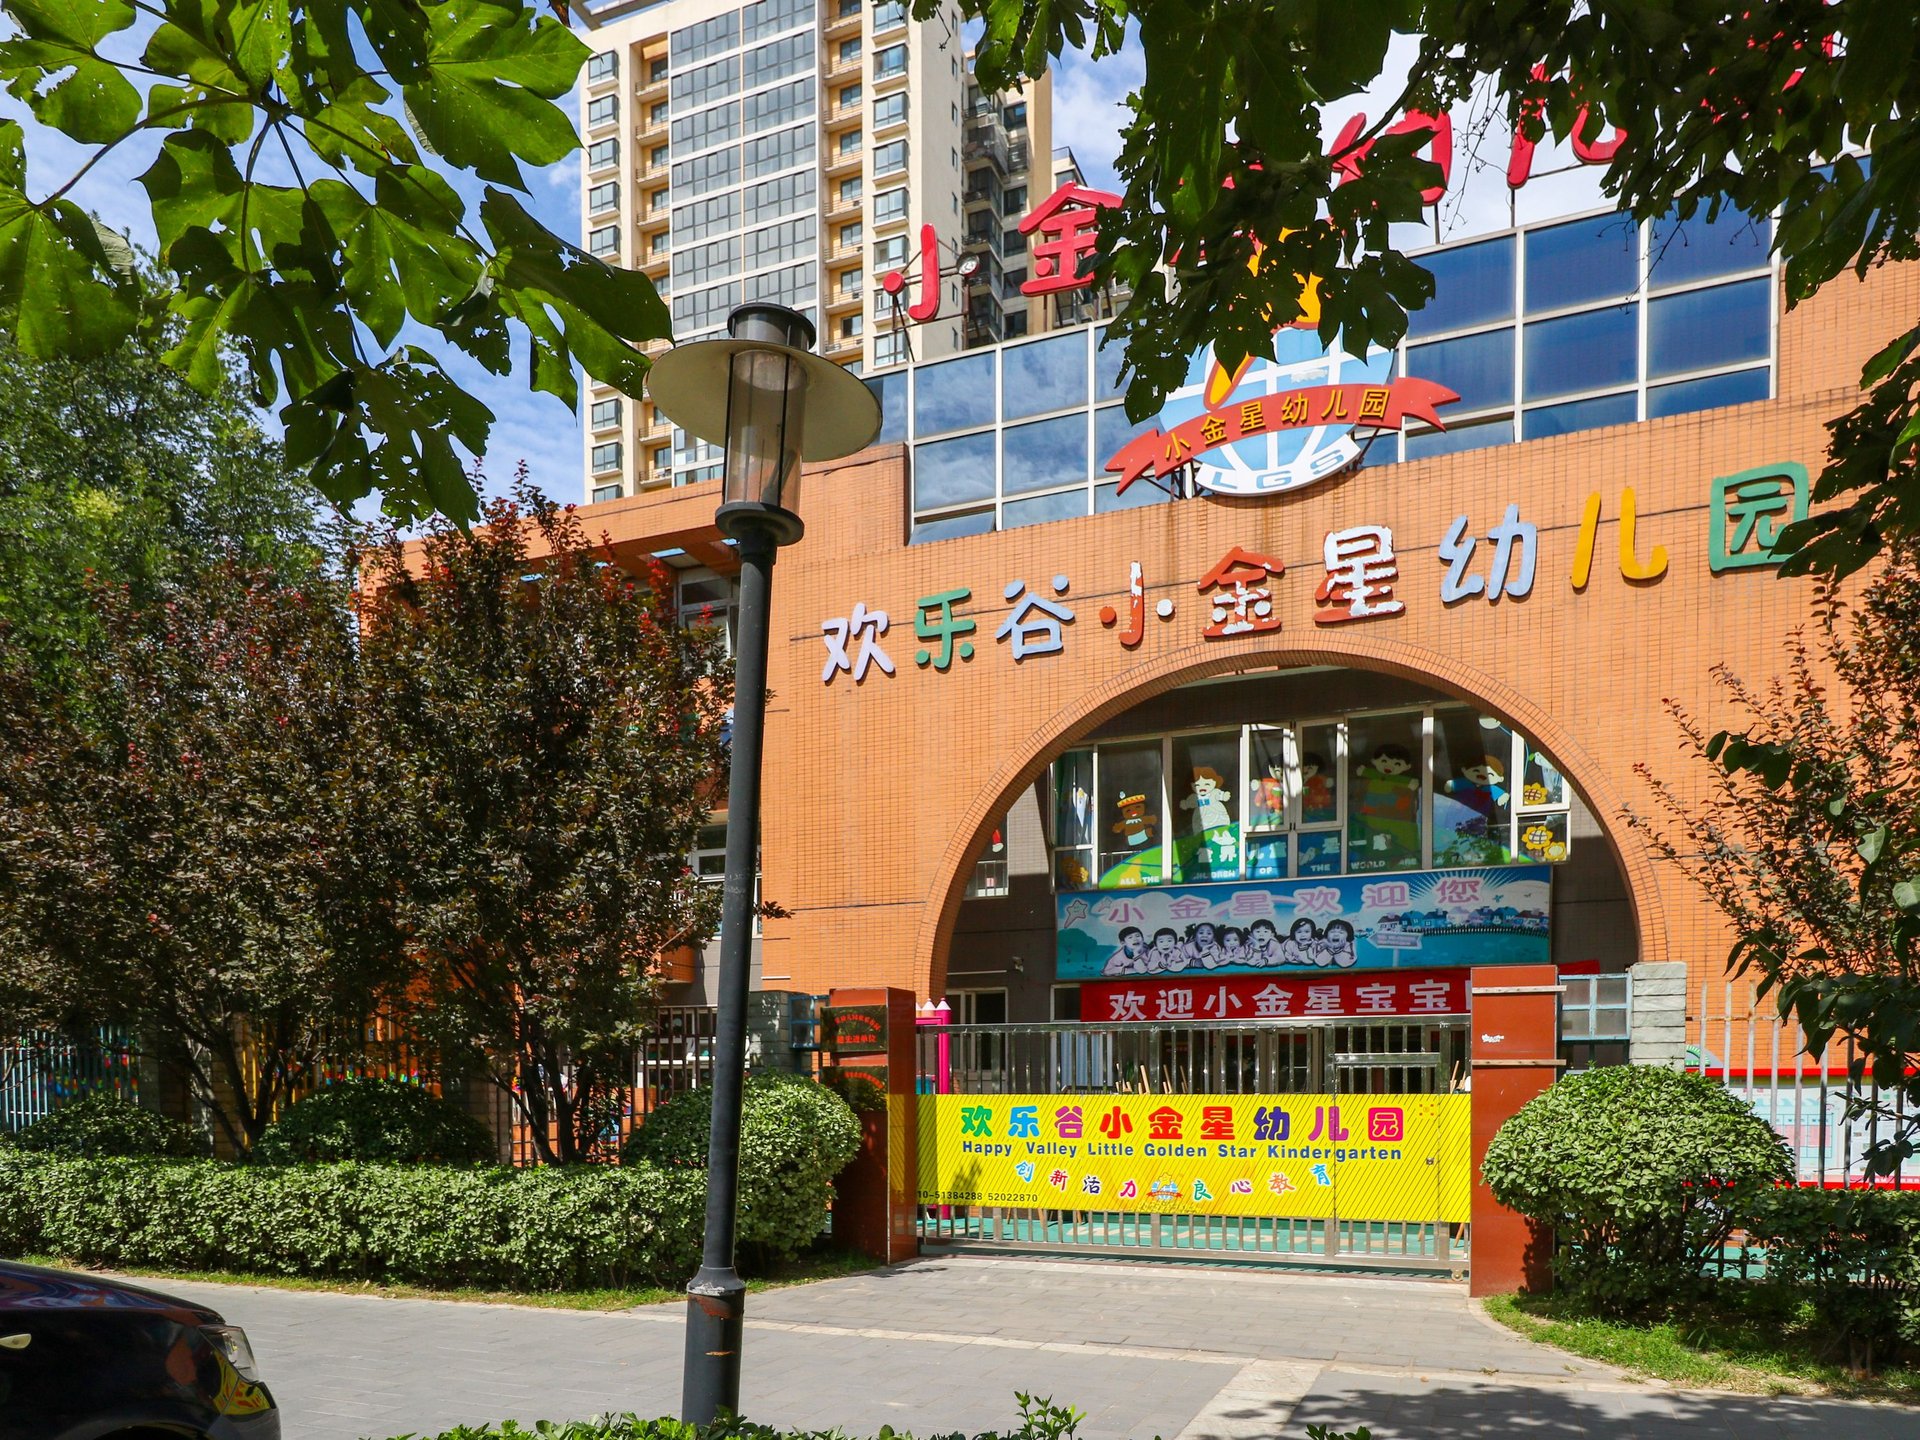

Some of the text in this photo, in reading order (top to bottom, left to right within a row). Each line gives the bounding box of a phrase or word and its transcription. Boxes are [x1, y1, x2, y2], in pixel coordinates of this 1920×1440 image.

[1164, 387, 1391, 461] 小金星幼儿园
[1211, 452, 1345, 489] LGS
[821, 461, 1812, 684] 欢乐谷小金星幼儿园
[1141, 875, 1160, 884] THE
[1258, 866, 1273, 875] OF
[1310, 864, 1331, 872] THE
[1350, 860, 1386, 870] WORLD
[1106, 877, 1484, 924] 小金星欢迎您
[1109, 978, 1471, 1021] 欢迎小金星宝宝
[960, 1104, 1404, 1142] 欢乐谷小金星幼儿园
[962, 1140, 1402, 1163] Happy Valley Little Golden Star Kindergarten
[988, 1192, 1038, 1202] 52022870
